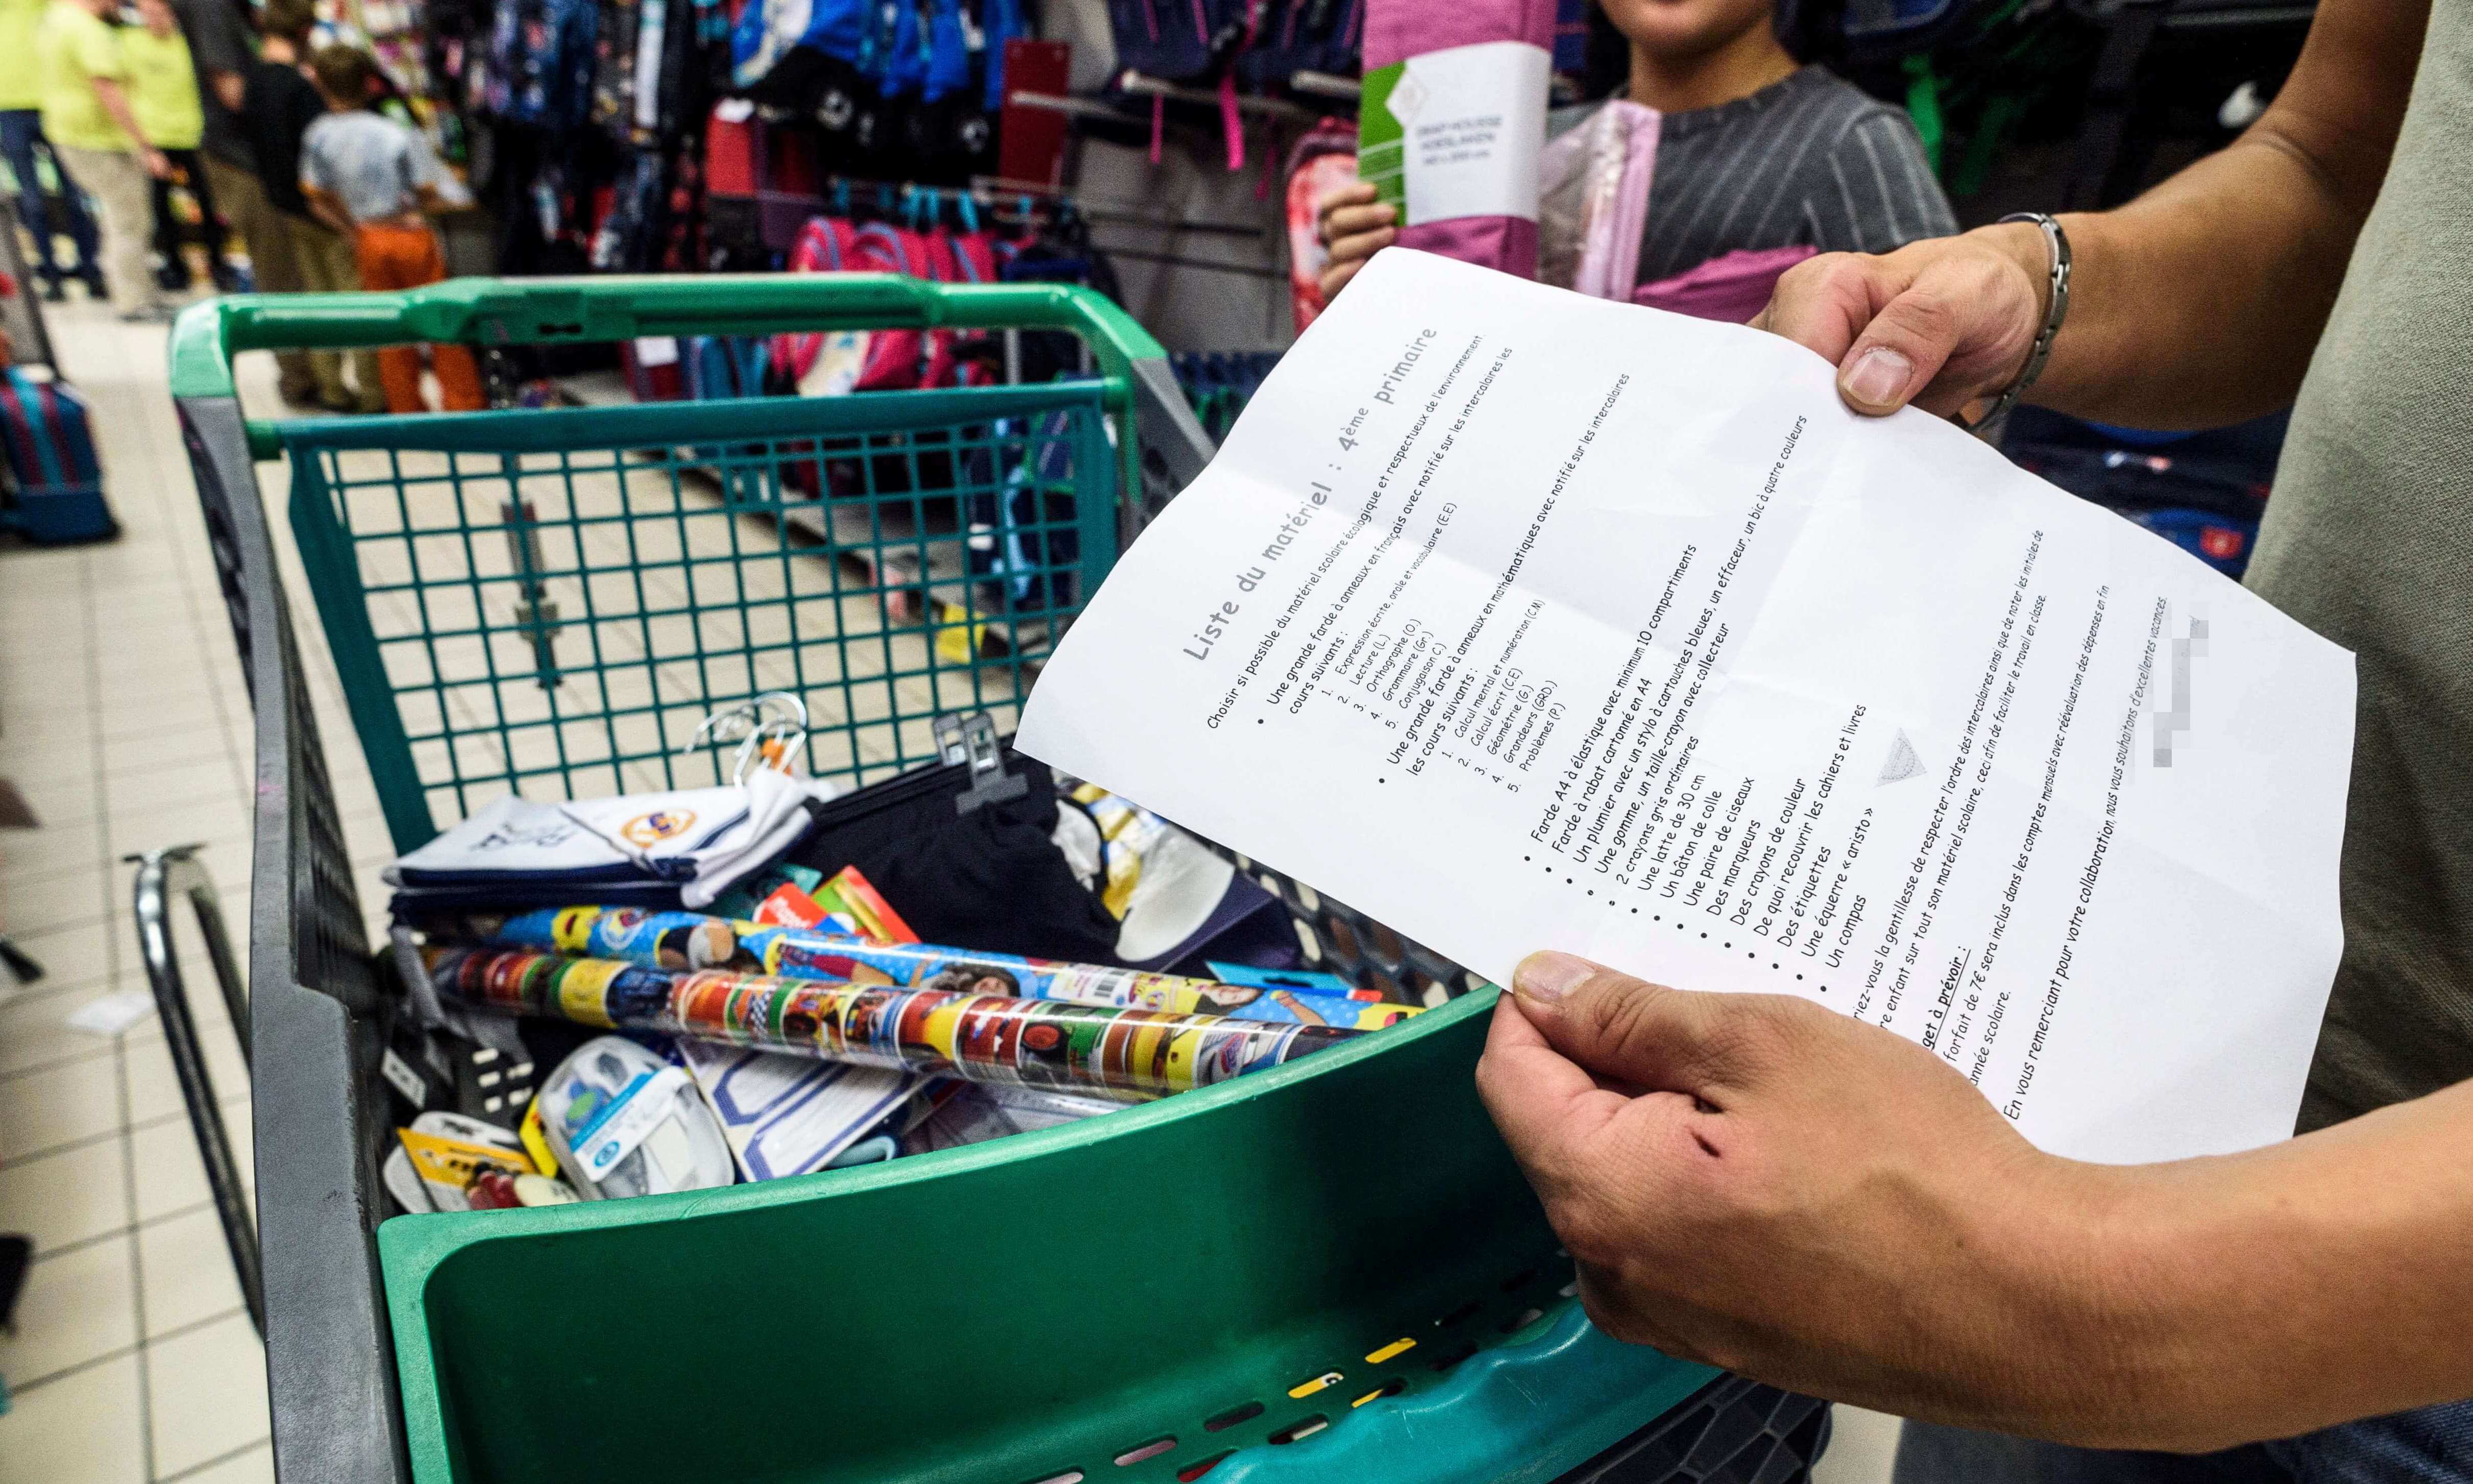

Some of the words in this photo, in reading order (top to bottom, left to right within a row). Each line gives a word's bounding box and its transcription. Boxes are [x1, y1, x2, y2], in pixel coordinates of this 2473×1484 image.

[1458, 360, 1504, 418] intercalaires
[1440, 433, 1455, 452] sur
[1447, 418, 1466, 433] les
[1780, 415, 1807, 460] couleurs
[1417, 450, 1445, 488] notifié
[1763, 460, 1785, 494] quatre
[1182, 600, 1240, 661] Liste
[1235, 566, 1267, 593] du
[1260, 481, 1332, 561] matériel
[1338, 407, 1369, 452] 4ème
[1373, 328, 1437, 405] primaire
[1402, 488, 1423, 515] avec
[1747, 502, 1765, 520] bic
[1755, 494, 1770, 503] à
[1373, 515, 1407, 553] français
[1743, 520, 1757, 535] un
[1206, 687, 1240, 729] Choisir
[1236, 673, 1249, 688] si
[1244, 629, 1280, 676] possible
[1275, 614, 1292, 629] du
[1286, 572, 1322, 615] matériel
[1317, 539, 1349, 574] scolaire
[1342, 490, 1382, 540] écologique
[1377, 475, 1390, 489] et
[1385, 412, 1430, 475] respectueux
[1423, 400, 1439, 413] de
[1367, 553, 1381, 565] en
[1717, 537, 1752, 589] effaceur,
[1340, 564, 1373, 604] anneaux
[1648, 544, 1697, 630] compartiments
[1709, 589, 1724, 604] un
[2096, 585, 2110, 599] fin
[1329, 603, 1345, 612] à
[2096, 598, 2106, 611] en
[2149, 596, 2168, 639] vacances.
[1309, 612, 1339, 642] farde
[1636, 630, 1653, 647] 10
[1683, 607, 1717, 648] bleues,
[2080, 609, 2103, 654] dépenses
[1286, 642, 1317, 683] grande
[1337, 695, 1351, 704] 2.
[1348, 650, 1379, 686] Lecture
[1372, 634, 1391, 650] (L.)
[1352, 703, 1367, 713] 3.
[1366, 637, 1409, 693] Orthographe
[1402, 618, 1422, 637] (O.)
[1615, 646, 1646, 689] minimum
[1696, 622, 1729, 681] collecteur
[2074, 652, 2090, 673] des
[1289, 681, 1315, 715] cours
[1310, 636, 1345, 682] suivants
[1369, 711, 1383, 720] 4.
[1381, 652, 1419, 701] Grammaire
[1412, 630, 1435, 652] (Gr.)
[1636, 677, 1653, 697] A4
[1657, 648, 1693, 708] cartouches
[2128, 639, 2157, 707] d'excellentes
[1265, 682, 1290, 705] Une
[1602, 689, 1622, 716] avec
[1629, 697, 1644, 712] en
[1683, 680, 1702, 708] avec
[2056, 672, 2084, 734] réévaluation
[1647, 707, 1664, 717] à
[1840, 703, 1867, 735] livres
[1473, 766, 1488, 776] 3.
[1486, 703, 1522, 756] Géométrie
[1514, 684, 1535, 703] (G.)
[1491, 774, 1505, 784] 4.
[1502, 710, 1538, 764] Grandeurs
[1531, 679, 1558, 712] (GRD.)
[1506, 782, 1522, 793] 5.
[1518, 719, 1555, 772] Problèmes
[1547, 702, 1566, 720] (P.)
[1569, 716, 1608, 770] élastique
[1602, 710, 1635, 765] cartonné
[1636, 718, 1658, 748] stylo
[1643, 708, 1689, 779] taille-crayon
[1838, 736, 1852, 751] et
[2051, 733, 2066, 758] avec
[2115, 707, 2138, 767] souhaitons
[1628, 747, 1643, 764] un
[1554, 779, 1572, 802] A4
[1562, 770, 1579, 781] à
[1581, 764, 1607, 802] rabat
[1613, 764, 1634, 793] avec
[1636, 781, 1652, 797] un
[1690, 774, 1707, 791] cm
[1817, 752, 1845, 799] cahiers
[2040, 756, 2058, 802] mensuels
[2109, 765, 2124, 791] vous
[1572, 801, 1589, 813] à
[1615, 873, 1630, 885] 2
[1625, 822, 1655, 873] crayons
[1650, 795, 1668, 823] gris
[1663, 735, 1699, 795] ordinaires
[1676, 792, 1695, 810] 30
[1701, 790, 1723, 819] colle
[1803, 799, 1824, 820] les
[2105, 791, 2118, 818] nous
[1530, 803, 1561, 843] Farde
[1550, 814, 1582, 854] Farde
[1585, 793, 1617, 845] plumier
[1612, 800, 1645, 849] gomme,
[1668, 812, 1686, 829] de
[1689, 821, 1707, 838] de
[2022, 801, 2047, 853] comptes
[1571, 844, 1593, 863] Un
[1649, 832, 1677, 864] latte
[1668, 840, 1699, 878] bâton
[1682, 880, 1706, 907] Une
[1699, 844, 1724, 880] paire
[1713, 824, 1732, 842] de
[1725, 776, 1755, 823] ciseaux
[1728, 898, 1753, 926] Des
[1746, 844, 1777, 897] crayons
[1767, 826, 1786, 843] de
[1779, 777, 1806, 824] couleur
[1779, 821, 1814, 885] recouvrir
[1593, 847, 1618, 874] Une
[1705, 888, 1729, 916] Des
[1722, 819, 1761, 888] marqueurs
[2011, 853, 2029, 872] les
[2078, 819, 2118, 904] collaboration,
[1636, 866, 1660, 891] Une
[1658, 880, 1680, 898] Un
[1800, 929, 1825, 957] Une
[1813, 872, 1848, 928] équerre
[1841, 859, 1852, 870] «
[1847, 818, 1871, 859] aristo
[1862, 807, 1874, 817] »
[2002, 872, 2022, 903] dans
[1766, 883, 1787, 915] quoi
[1776, 918, 1800, 948] Des
[1789, 845, 1831, 918] étiquettes
[1752, 916, 1773, 937] De
[1824, 947, 1846, 968] Un
[1838, 894, 1867, 946] compas
[1988, 903, 2011, 940] inclus
[2066, 905, 2087, 942] votre
[1980, 941, 1999, 972] sera
[2054, 942, 2073, 981] pour
[1968, 969, 1986, 991] 7€
[1962, 993, 1979, 1012] de
[2027, 978, 2063, 1061] remerciant
[1942, 1012, 1972, 1062] forfait
[2015, 1061, 2035, 1096] vous
[2002, 1099, 2024, 1121] En
